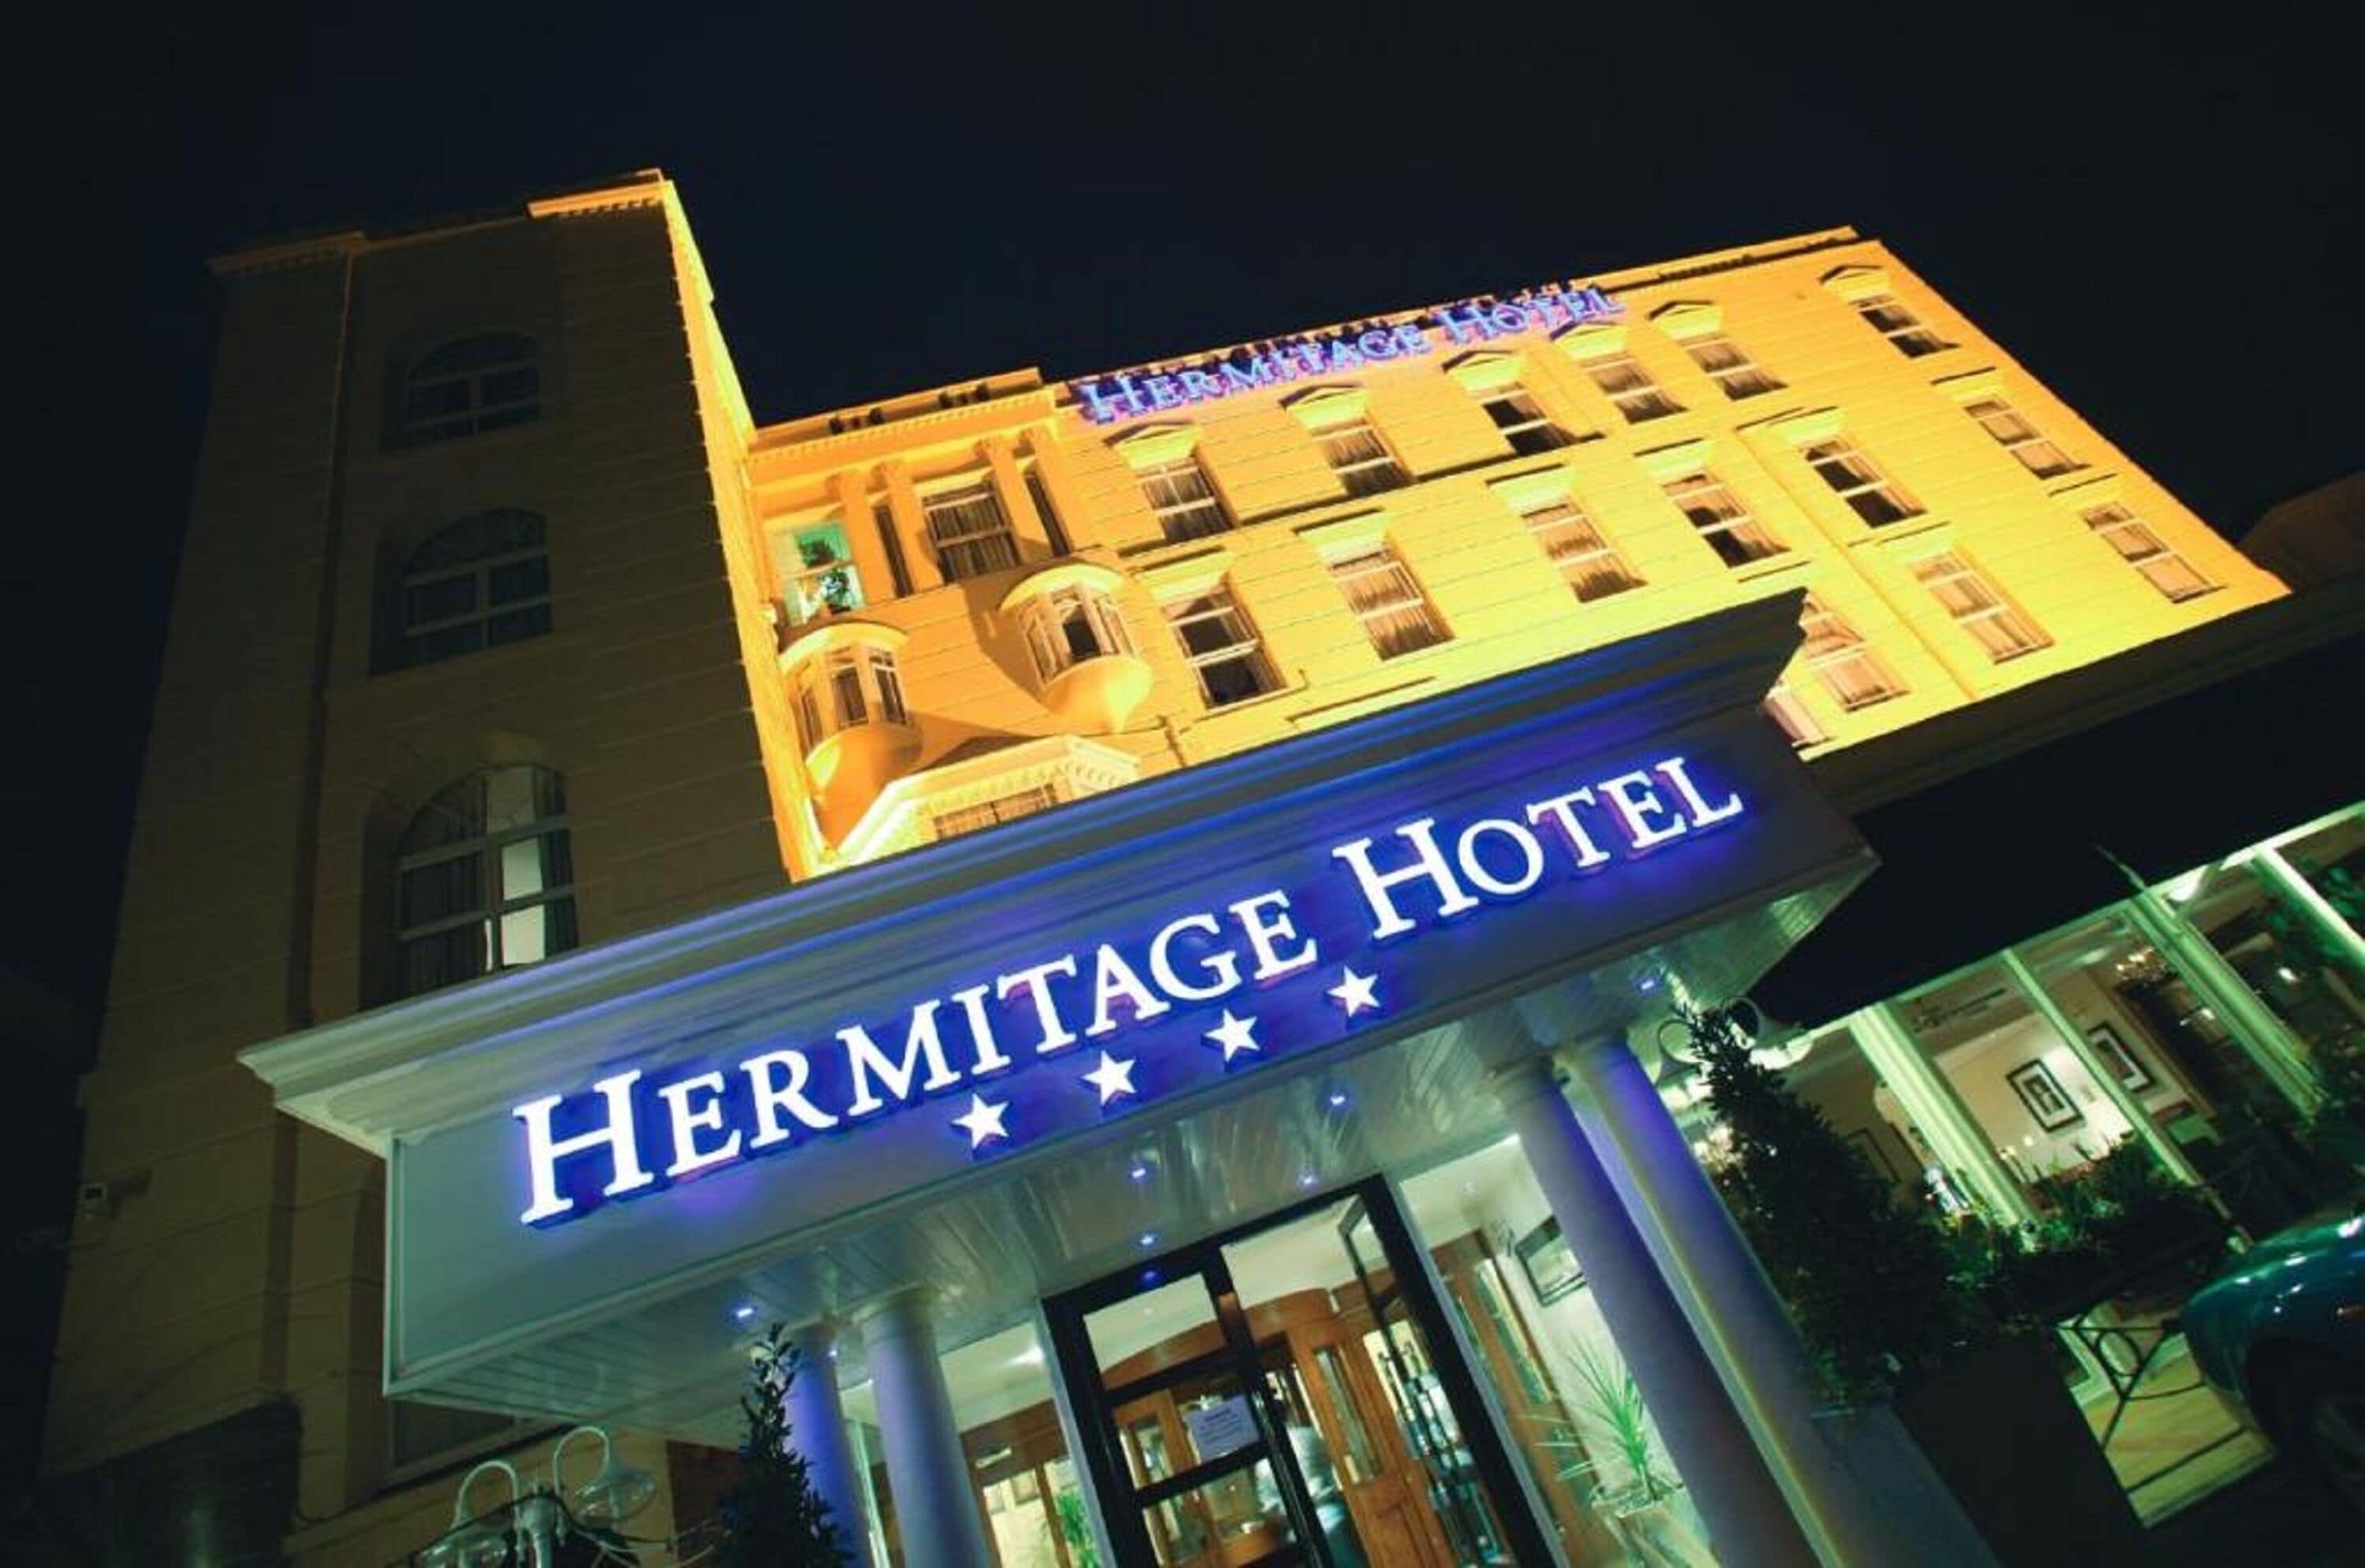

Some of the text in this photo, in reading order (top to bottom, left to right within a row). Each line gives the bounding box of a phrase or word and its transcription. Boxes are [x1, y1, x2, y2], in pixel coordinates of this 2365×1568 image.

[1079, 286, 1626, 423] HERMITAGE HOTEL
[512, 757, 1744, 1224] HERMITAGE HOTEL
